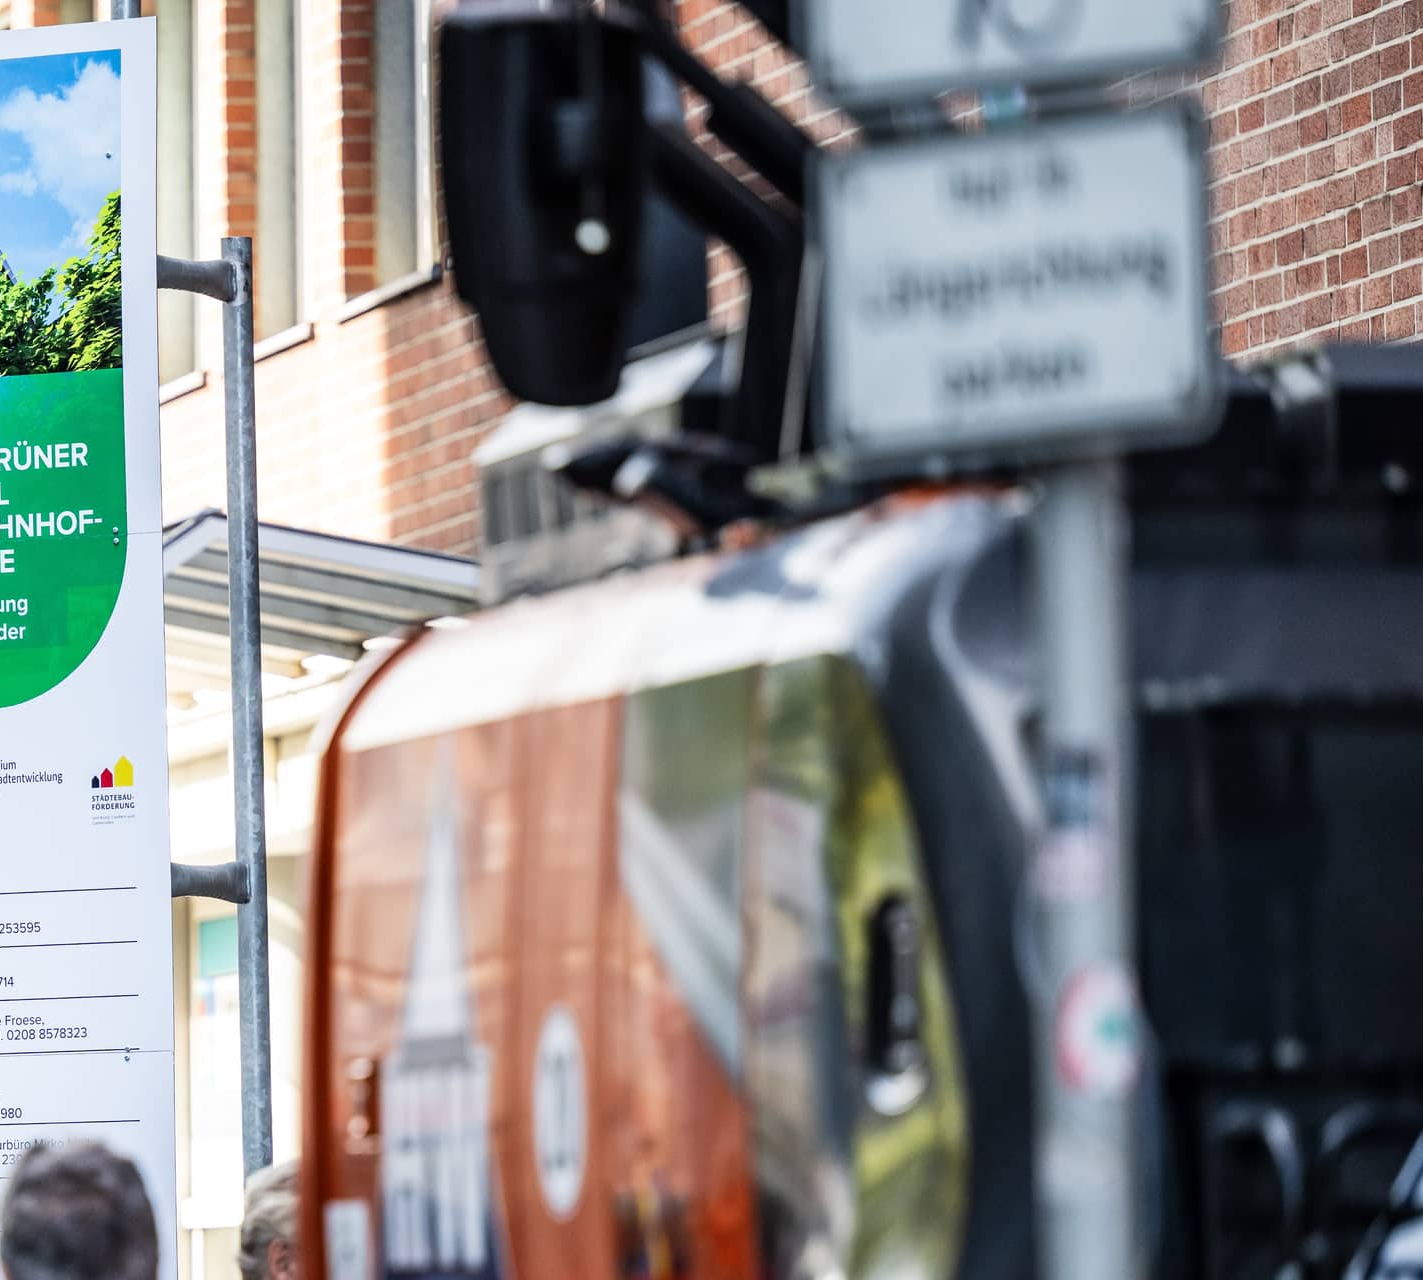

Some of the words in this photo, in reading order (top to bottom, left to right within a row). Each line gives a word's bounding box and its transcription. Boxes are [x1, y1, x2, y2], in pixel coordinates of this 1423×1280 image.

[91, 801, 134, 810] FÖRDERUNG
[4, 1015, 44, 1025] Froese,
[6, 1028, 35, 1040] 0208
[38, 1026, 87, 1039] 8578323
